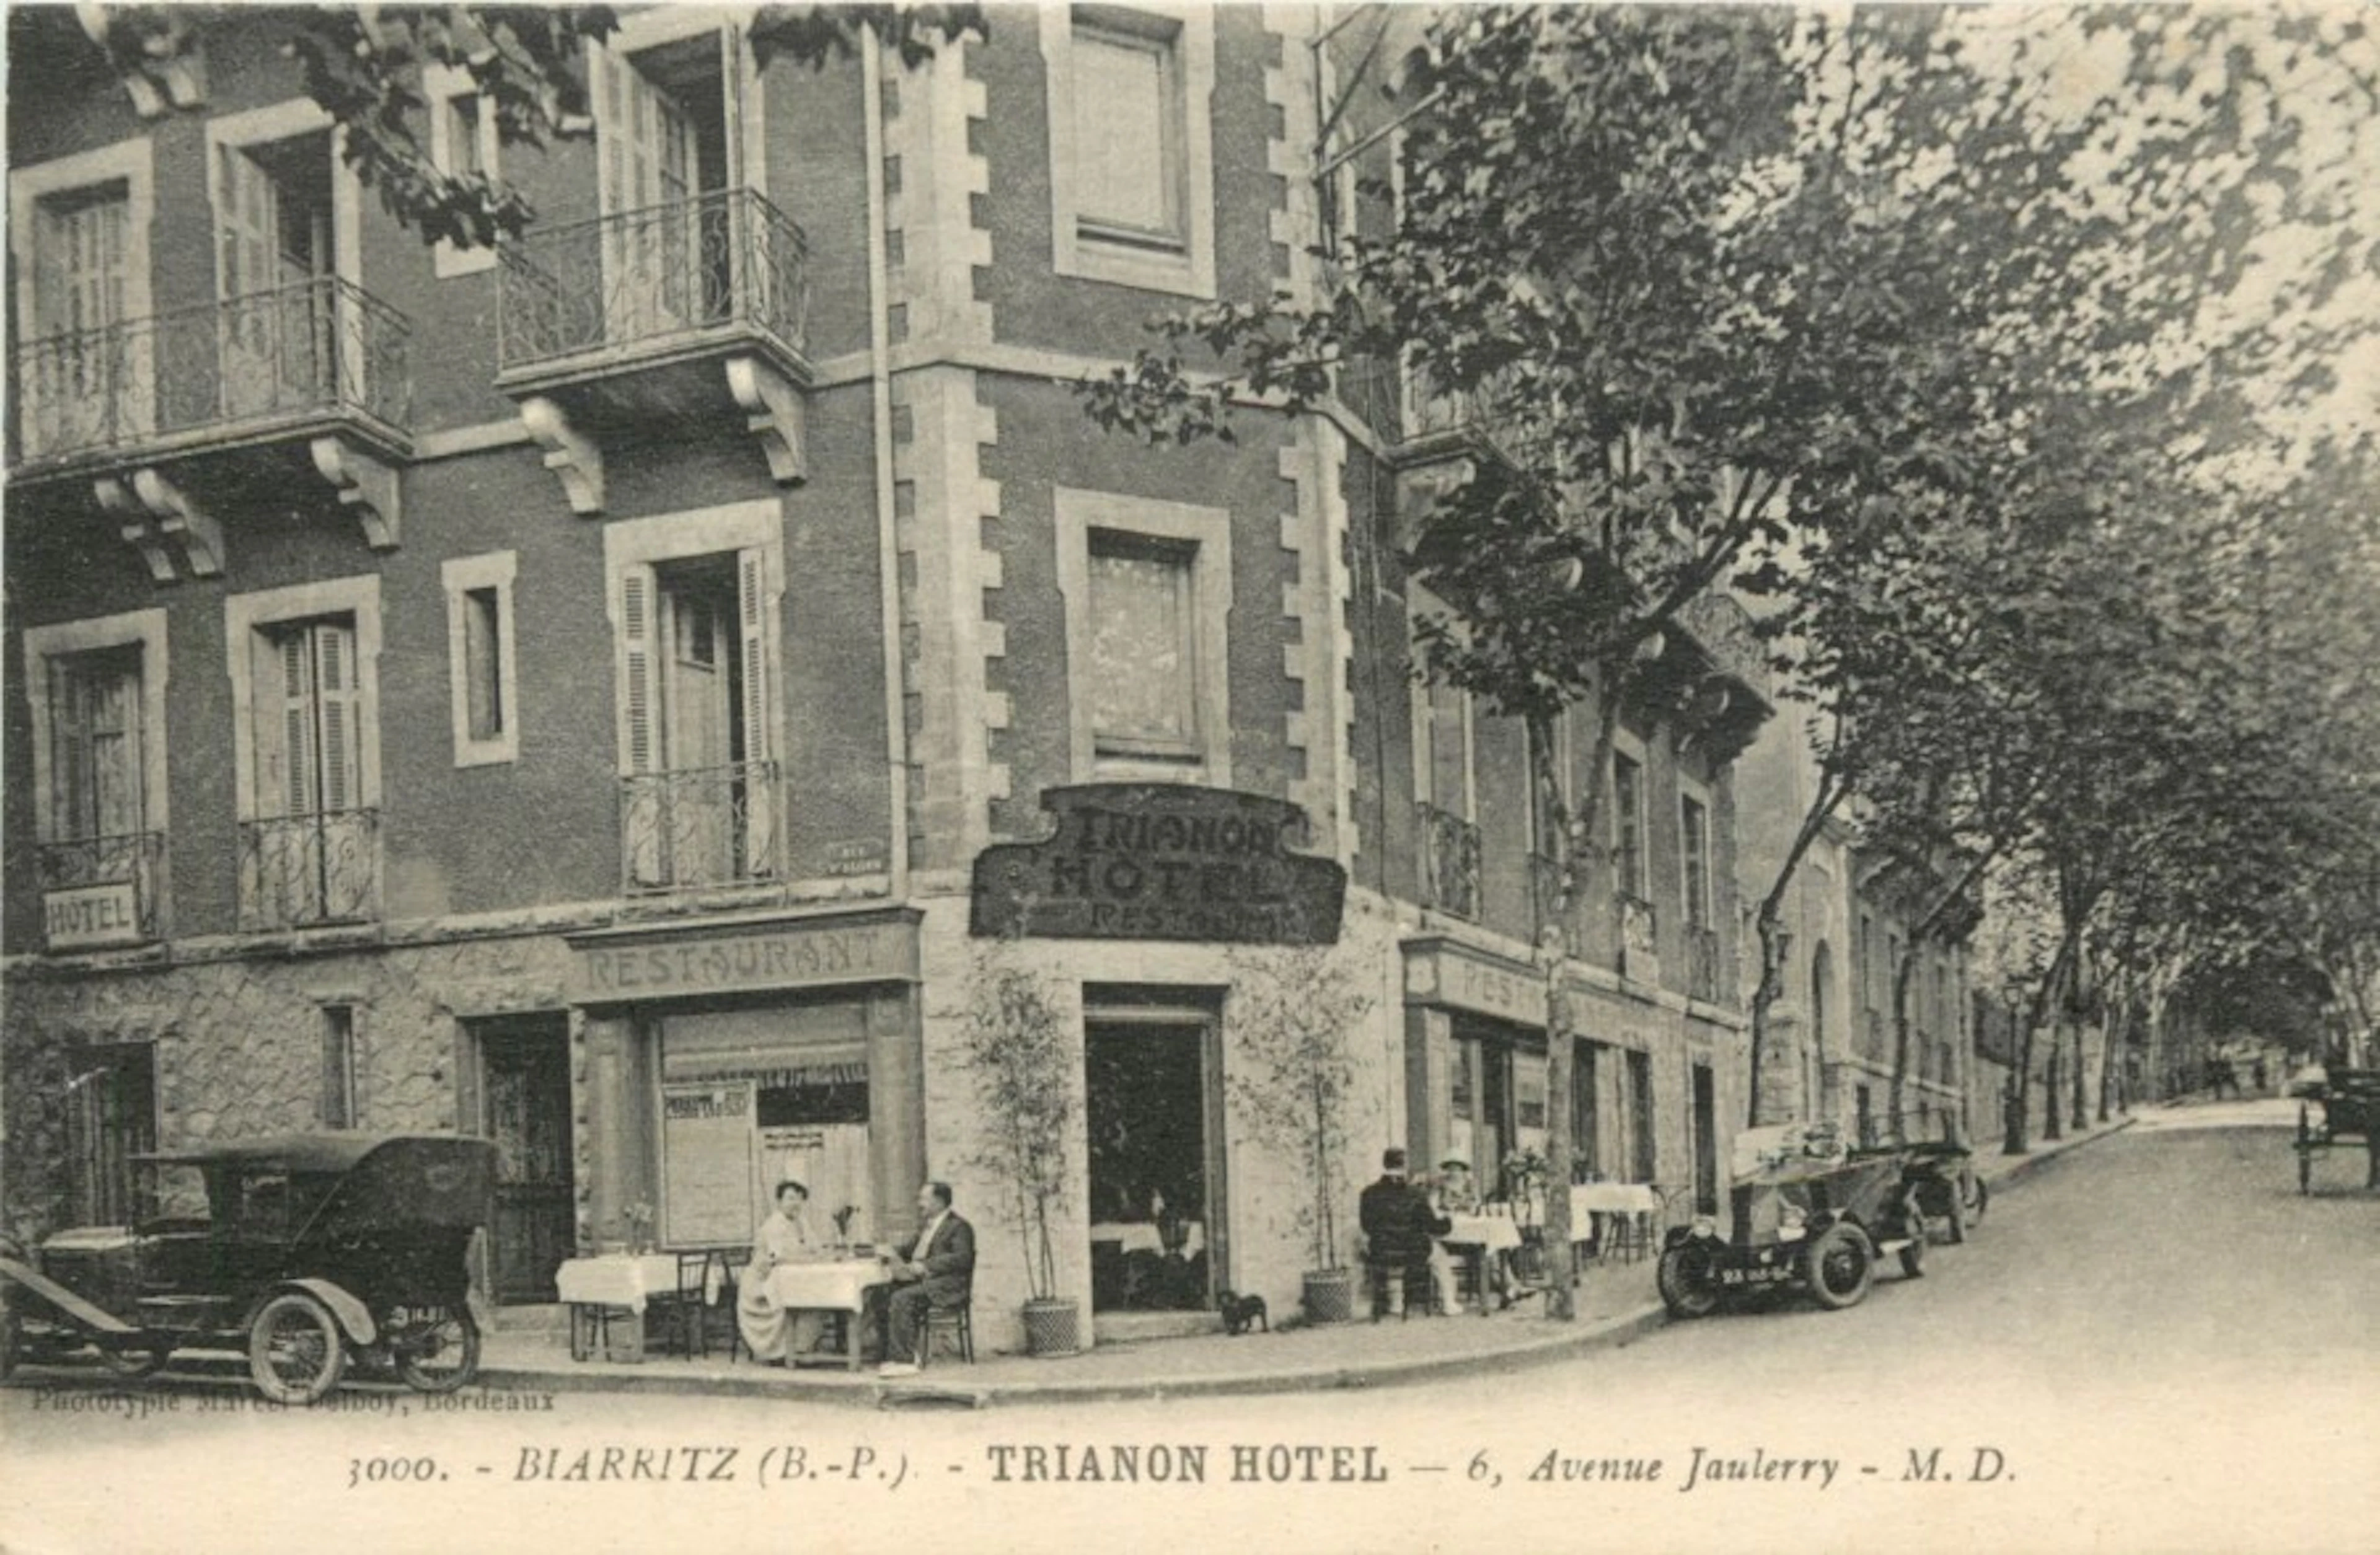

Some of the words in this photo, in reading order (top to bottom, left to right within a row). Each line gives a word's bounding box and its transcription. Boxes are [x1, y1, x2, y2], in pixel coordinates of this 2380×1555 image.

[1076, 807, 1277, 852] TRIANON
[1052, 855, 1289, 904] HOTEL
[584, 932, 878, 991] RESTAURANT
